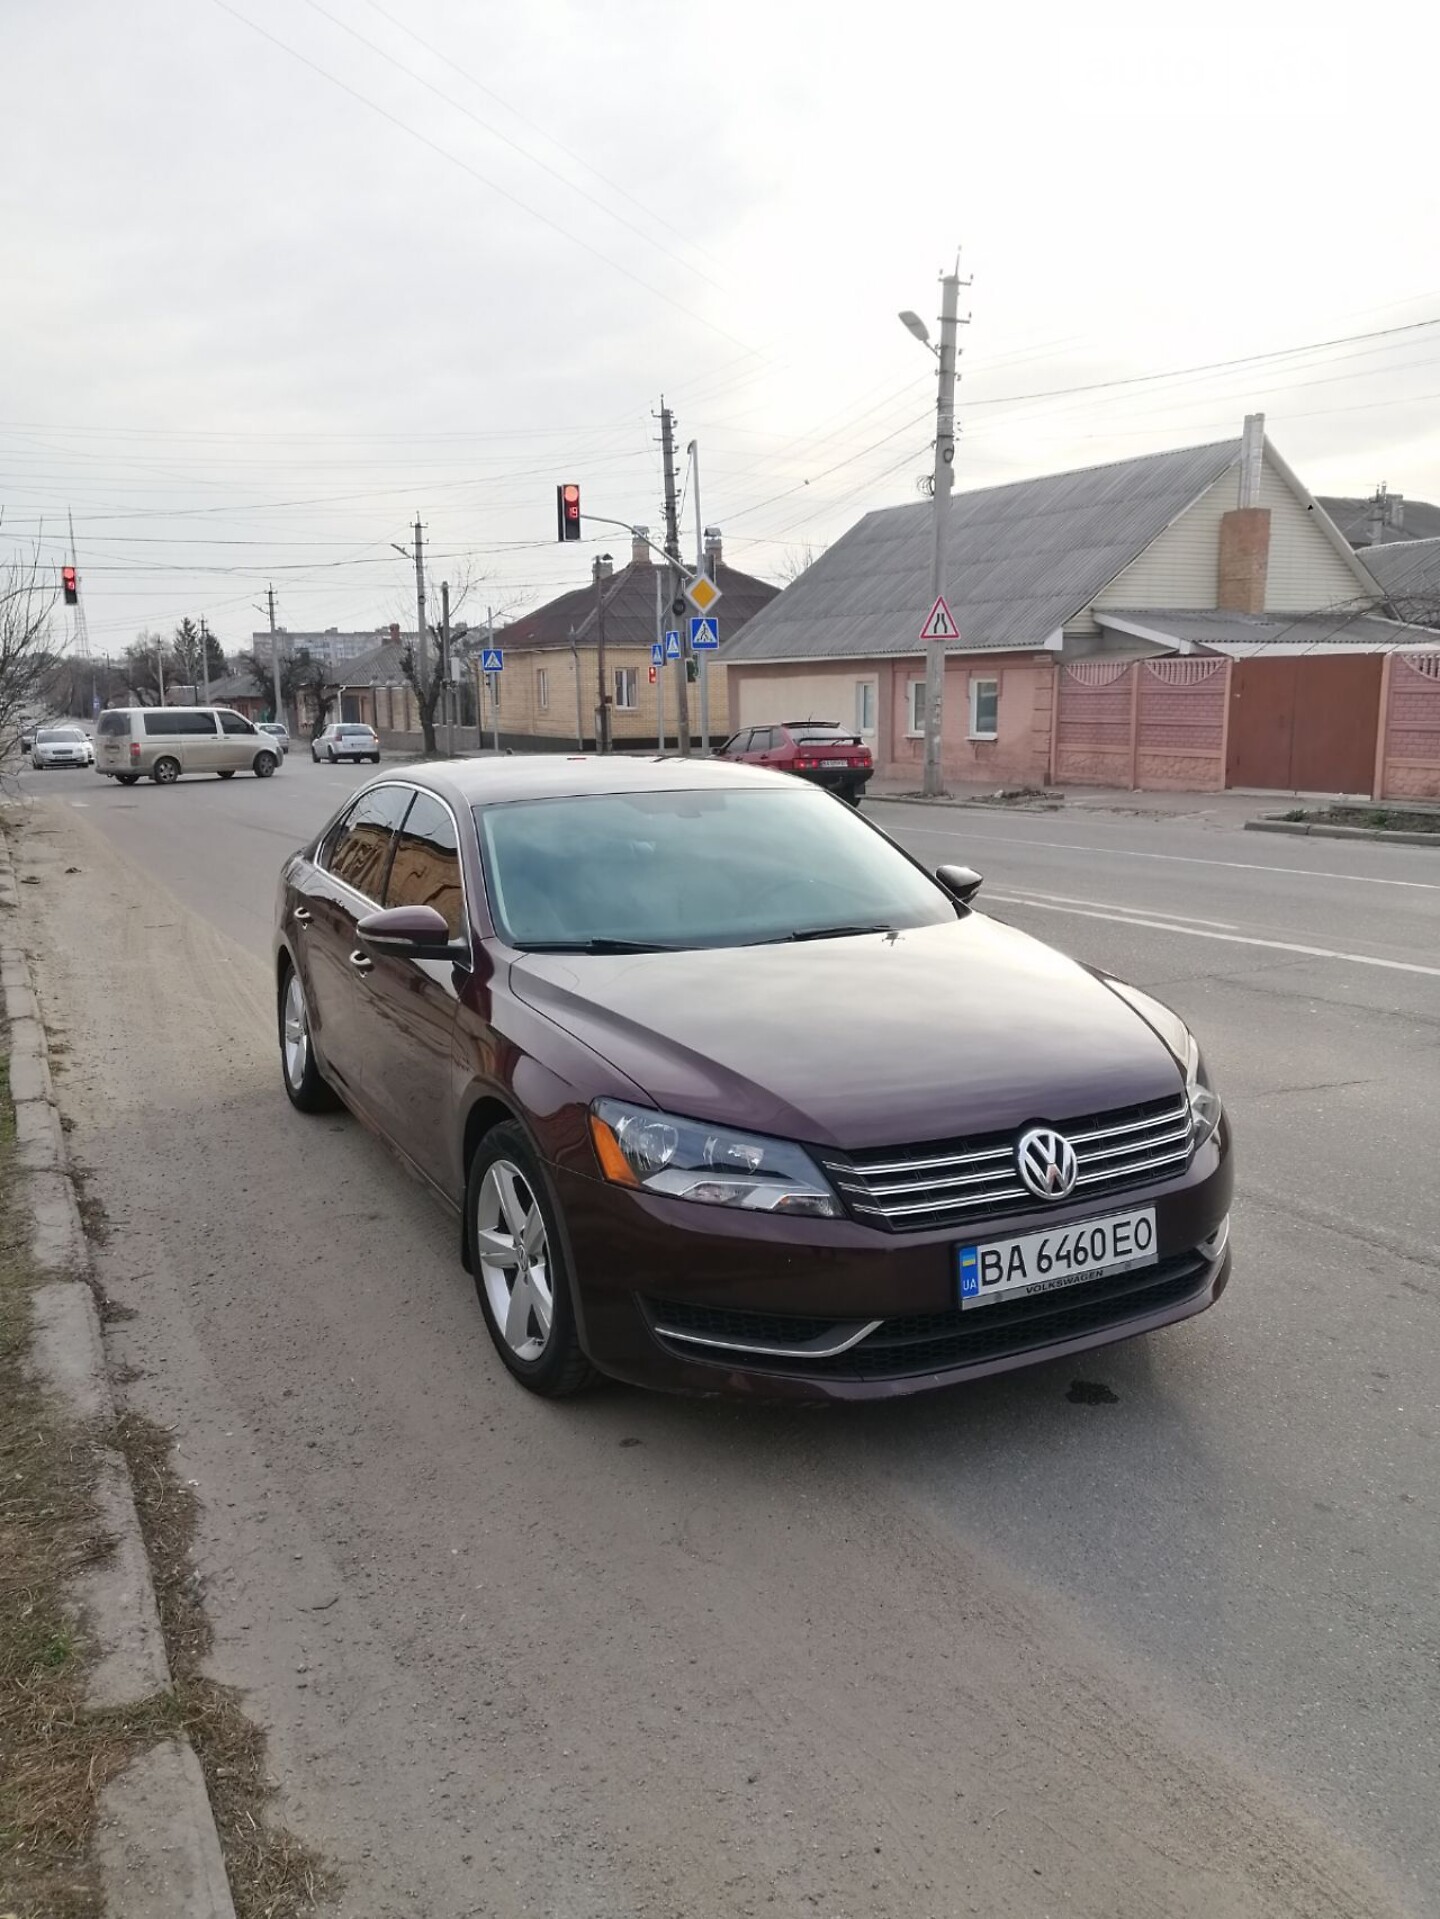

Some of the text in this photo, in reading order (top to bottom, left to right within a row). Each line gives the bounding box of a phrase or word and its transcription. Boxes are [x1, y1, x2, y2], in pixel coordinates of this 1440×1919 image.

[981, 1217, 1152, 1286] BA 6460 EO
[963, 1278, 977, 1290] UA
[1026, 1270, 1103, 1294] VOLKSWAGEN
